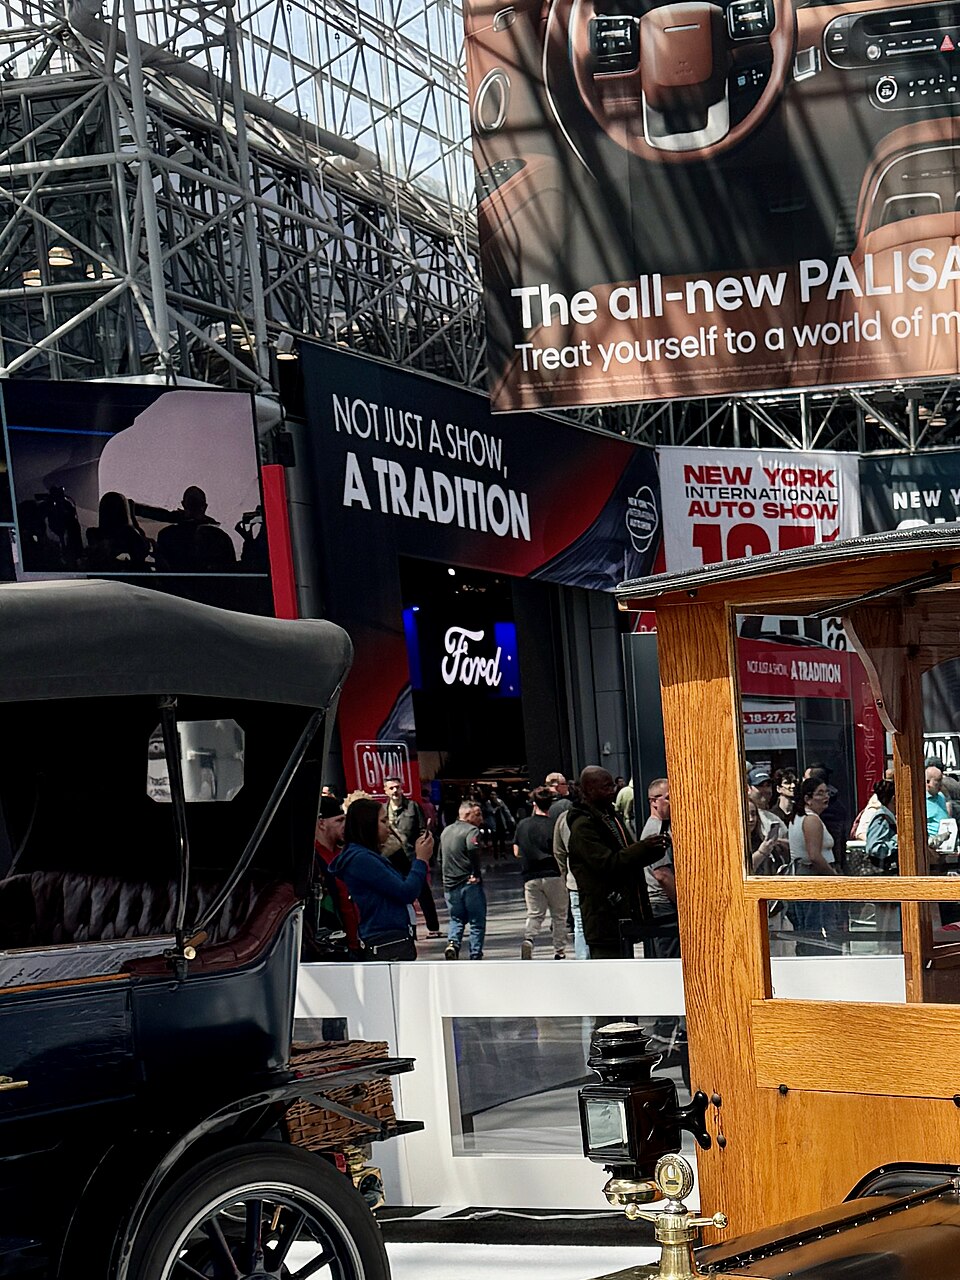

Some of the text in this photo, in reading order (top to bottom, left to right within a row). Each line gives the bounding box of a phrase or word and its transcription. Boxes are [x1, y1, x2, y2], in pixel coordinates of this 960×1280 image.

[511, 284, 597, 328] The
[609, 273, 787, 321] all-new
[515, 340, 591, 371] Treat
[598, 326, 718, 372] yourself
[724, 328, 755, 354] to
[765, 327, 784, 350] a
[792, 310, 882, 348] world
[891, 306, 923, 339] of
[332, 394, 507, 479] NOT JUST A SHOW,
[343, 451, 531, 541] A TRADITION
[684, 465, 838, 488] NEW YORK
[685, 486, 838, 502] INTERNATIONAL
[688, 501, 838, 520] AUTO SHOW
[893, 490, 941, 510] NEW
[441, 626, 502, 687] Ford
[798, 661, 841, 683] TRADITION
